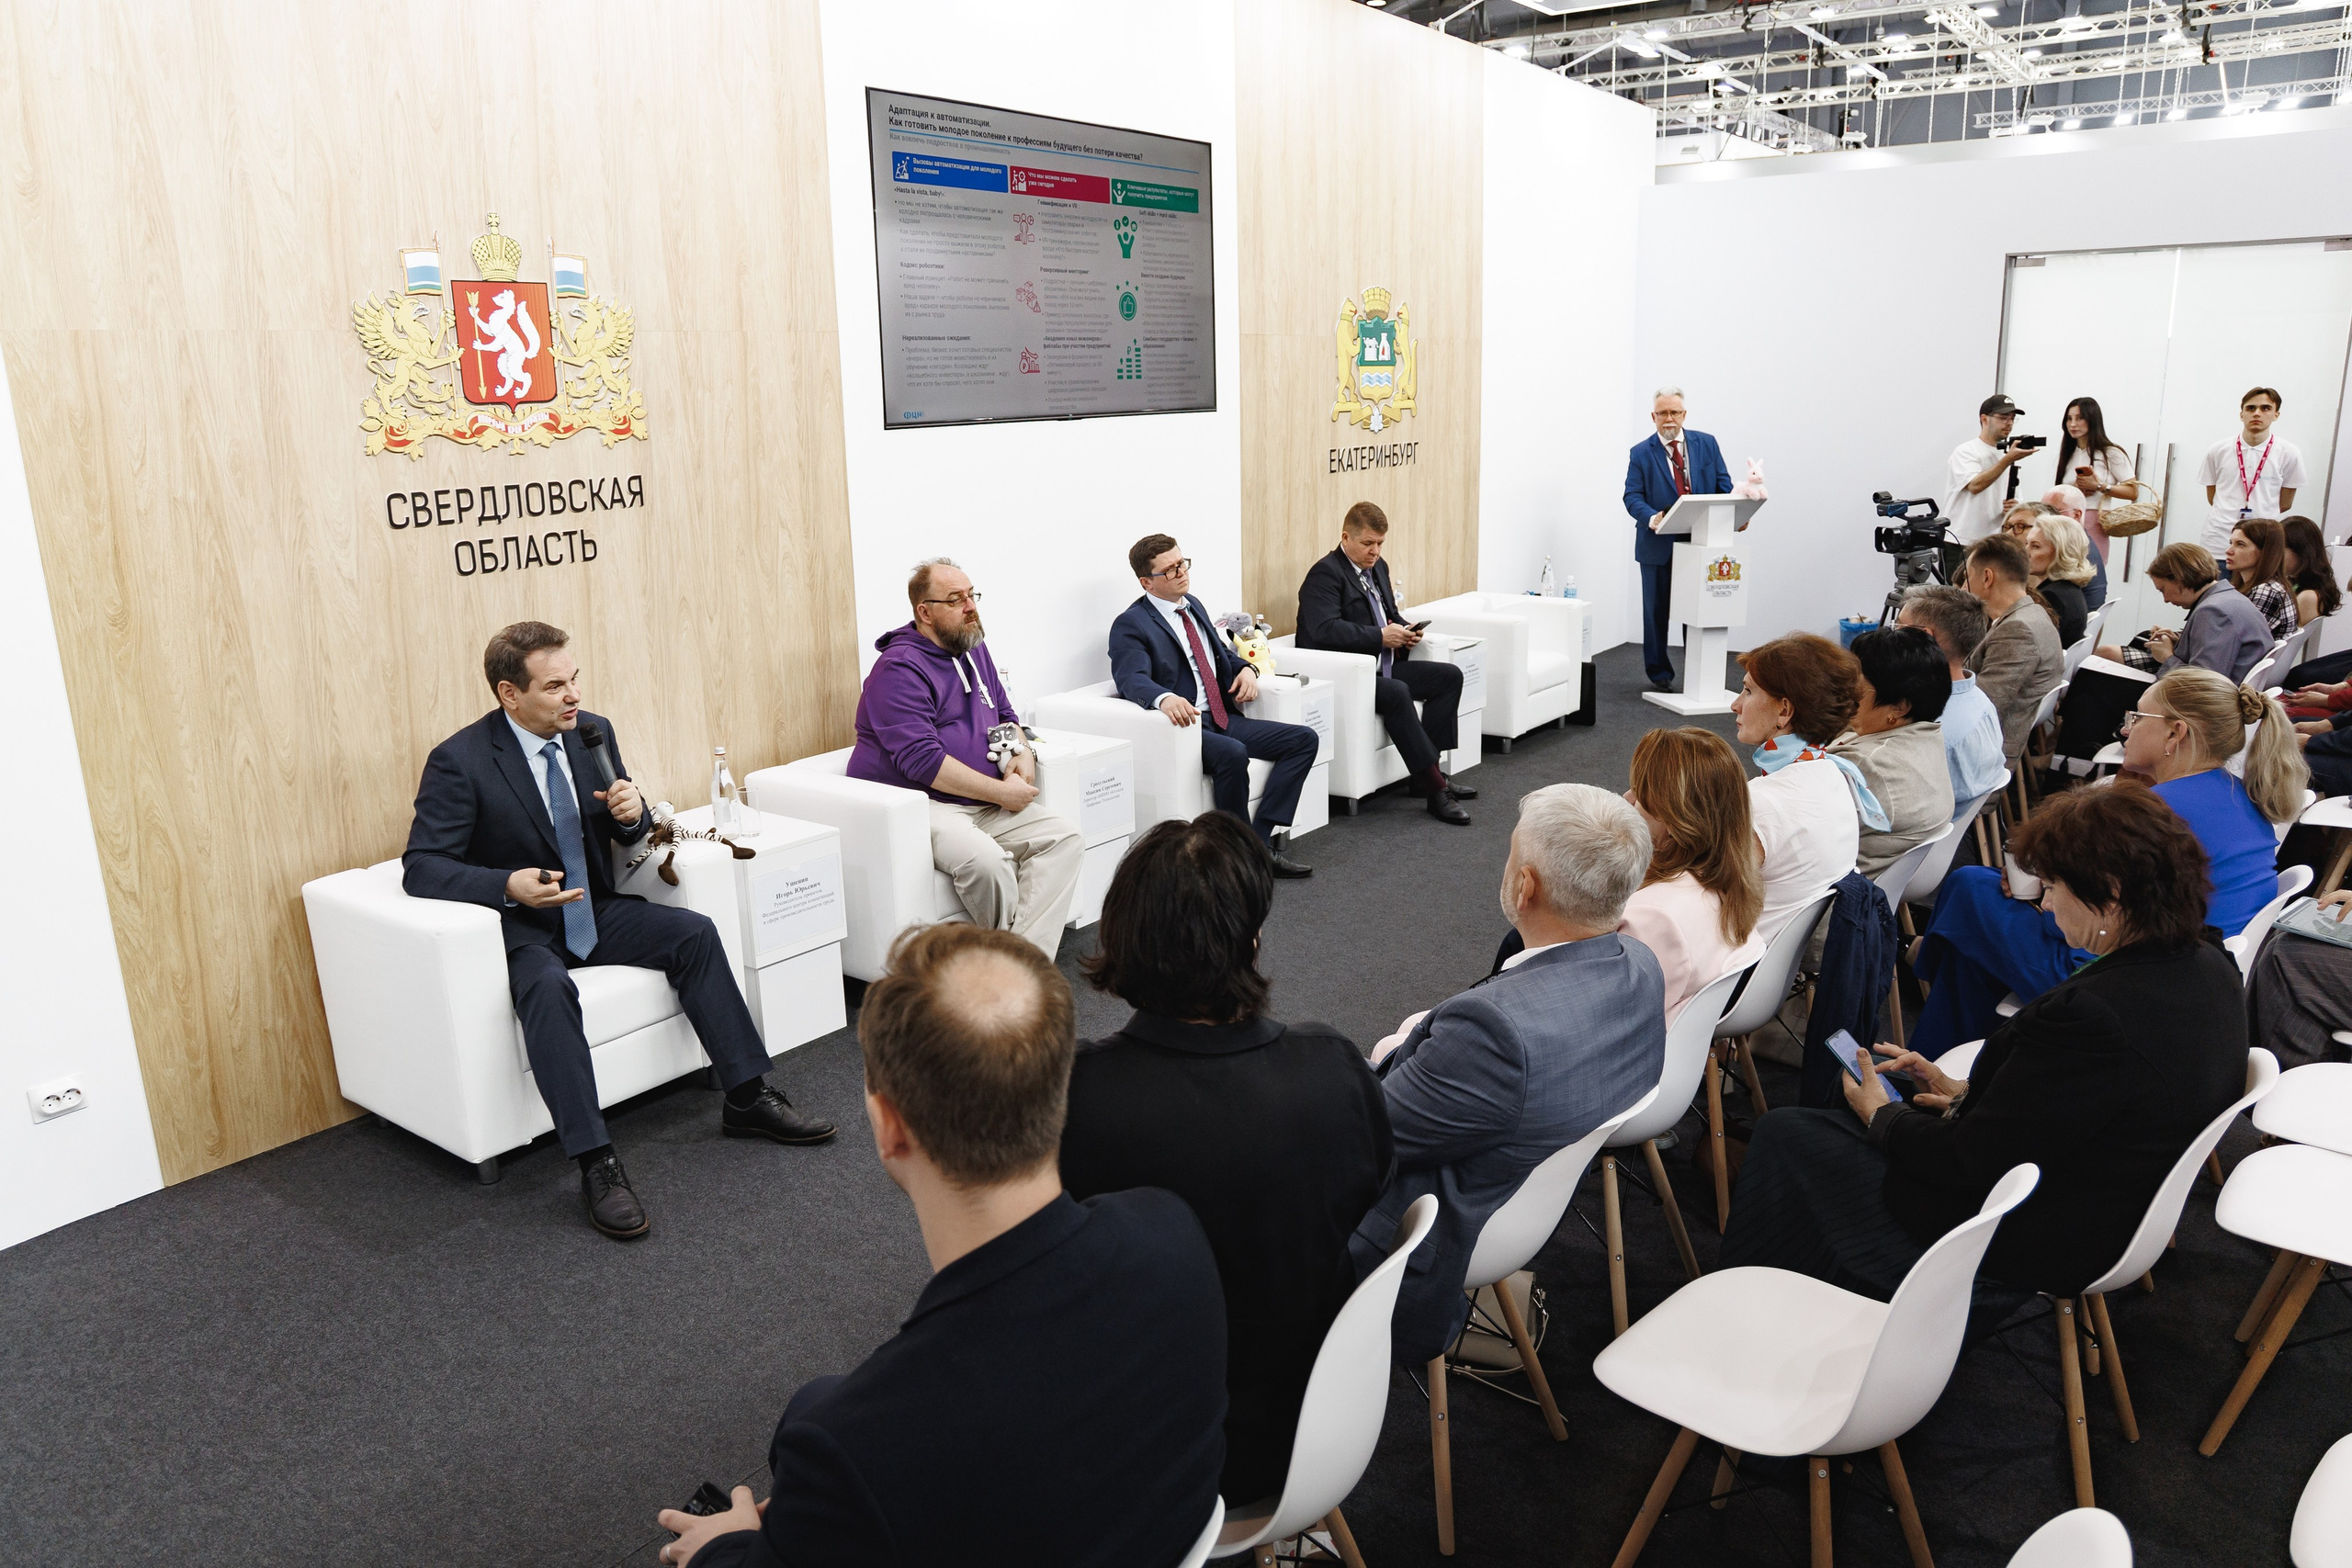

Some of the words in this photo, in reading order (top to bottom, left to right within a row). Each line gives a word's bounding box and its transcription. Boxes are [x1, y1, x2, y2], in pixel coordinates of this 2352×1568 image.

[888, 105, 928, 118] Адаптация
[937, 114, 991, 127] автоматизации.
[889, 117, 902, 126] Как
[905, 120, 936, 130] готовить
[939, 125, 969, 136] молодое
[970, 130, 1006, 141] поколение
[1013, 136, 1051, 148] профессиям
[1053, 141, 1081, 152] будущего
[1083, 145, 1093, 153] без
[1095, 148, 1114, 157] потери
[1115, 152, 1143, 160] качества?
[889, 133, 900, 141] Как
[926, 138, 958, 148] подростков
[1329, 442, 1419, 474] ЕКАТЕРИНБУРГ
[386, 475, 644, 529] СВЕРДЛОВСКАЯ
[454, 529, 597, 576] ОБЛАСТЬ
[775, 891, 793, 899] Игорь
[795, 882, 820, 894] Юрьевич
